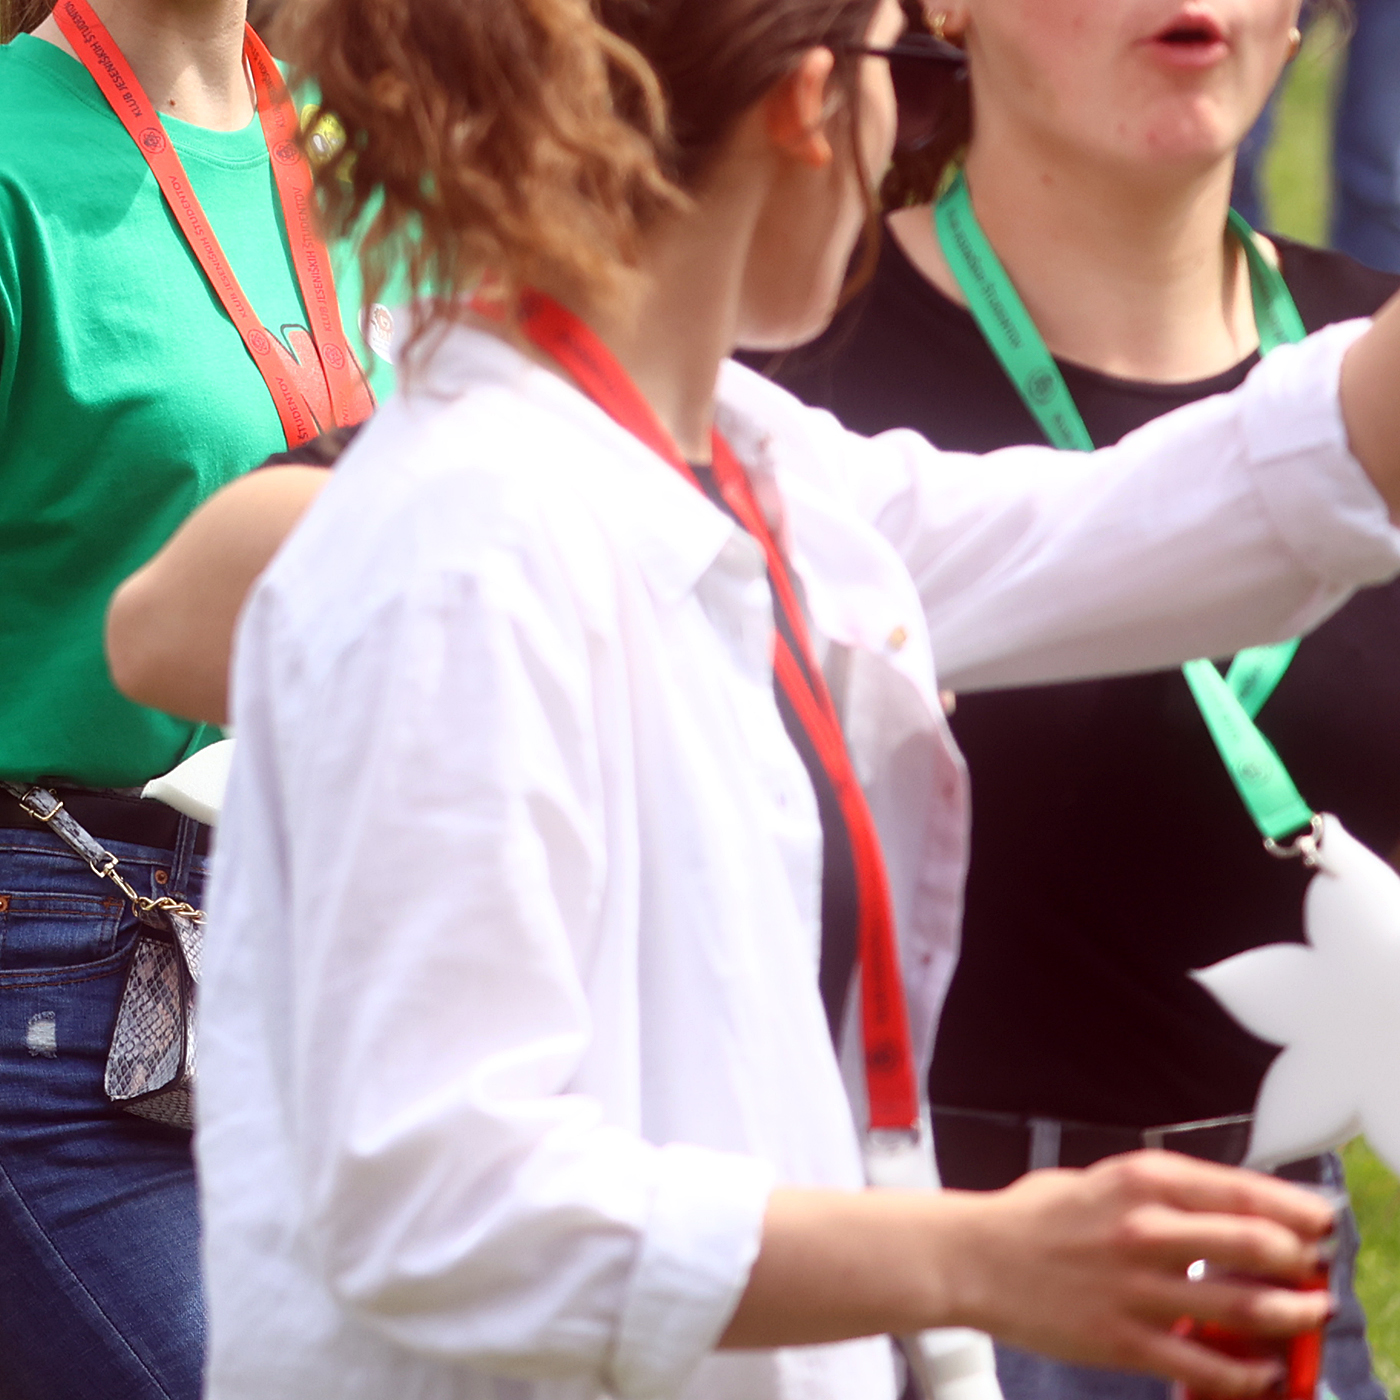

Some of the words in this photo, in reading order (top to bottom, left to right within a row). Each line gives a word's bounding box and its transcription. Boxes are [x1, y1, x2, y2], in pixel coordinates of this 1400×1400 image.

[122, 92, 143, 118] KLUB
[168, 175, 205, 236] ŠTUDENTOV
[201, 236, 234, 291] JESENIŠKIH
[306, 250, 327, 304] JESENIŠKIH
[318, 303, 332, 332] KLUB
[275, 376, 309, 440] ŠTUDENTOV
